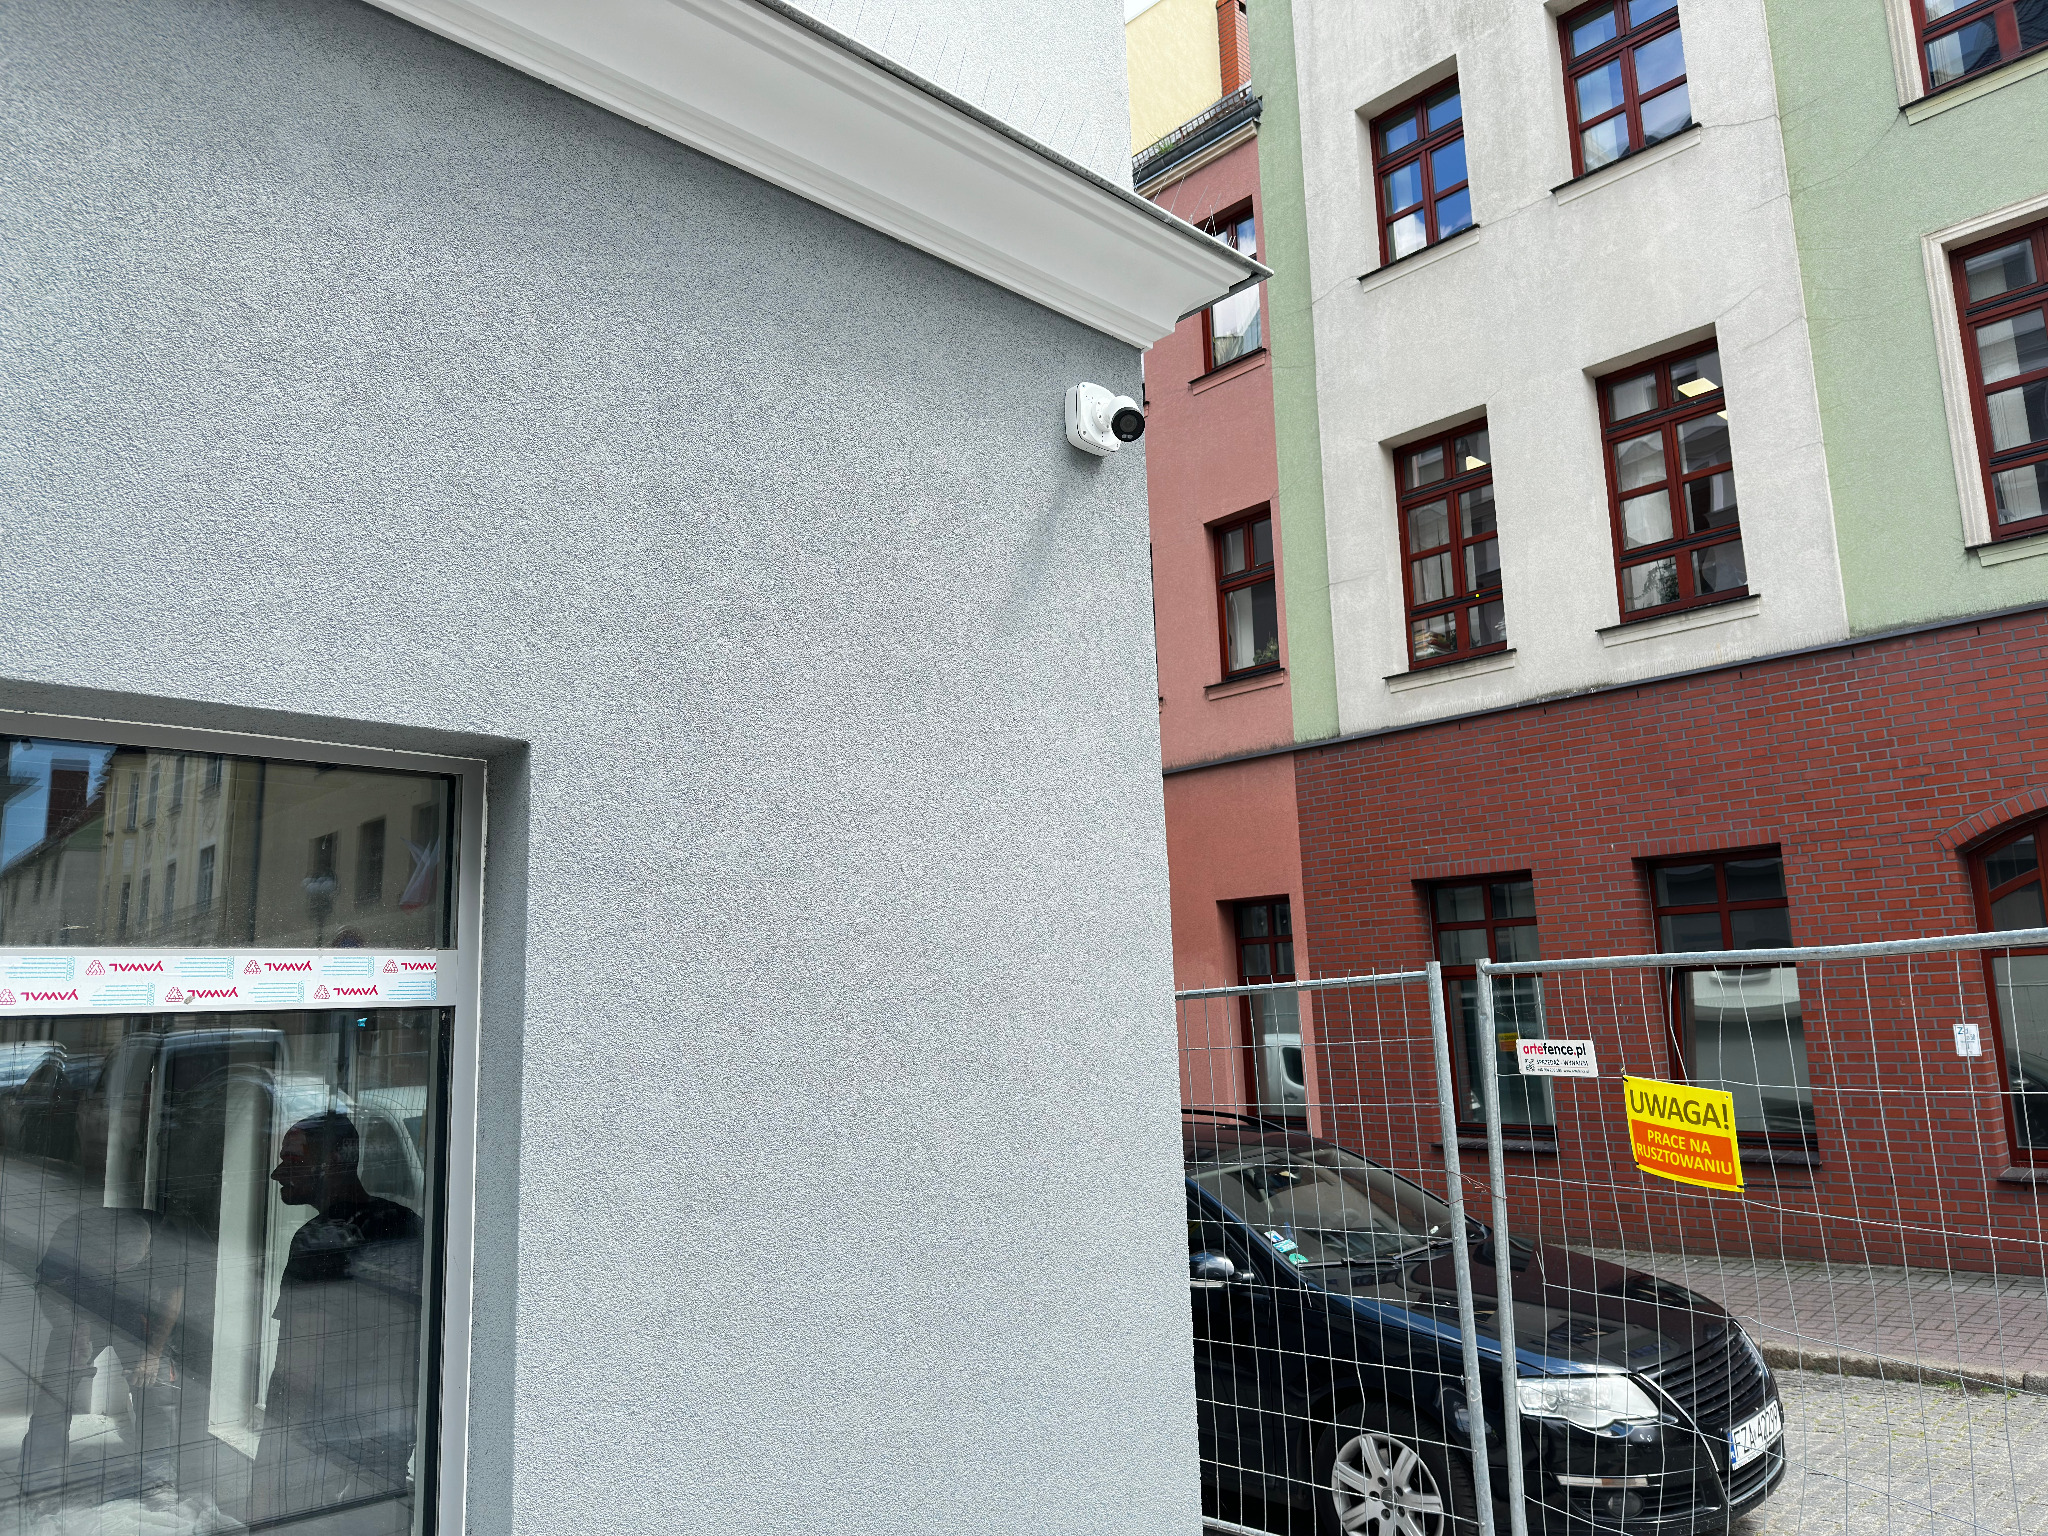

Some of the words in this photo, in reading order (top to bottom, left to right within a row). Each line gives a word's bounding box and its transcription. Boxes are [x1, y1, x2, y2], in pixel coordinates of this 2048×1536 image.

[109, 960, 164, 972] YAWAL
[264, 960, 313, 972] YAWAL
[401, 962, 436, 971] AWAL
[20, 988, 79, 1001] YAWAL
[333, 984, 379, 996] YAWAL
[1523, 1042, 1586, 1058] artefence.pl
[1630, 1089, 1730, 1131] UWAGA!
[1647, 1129, 1686, 1150] PRACE
[1689, 1138, 1712, 1155] NA
[1636, 1142, 1733, 1175] RUSZTOWANIU
